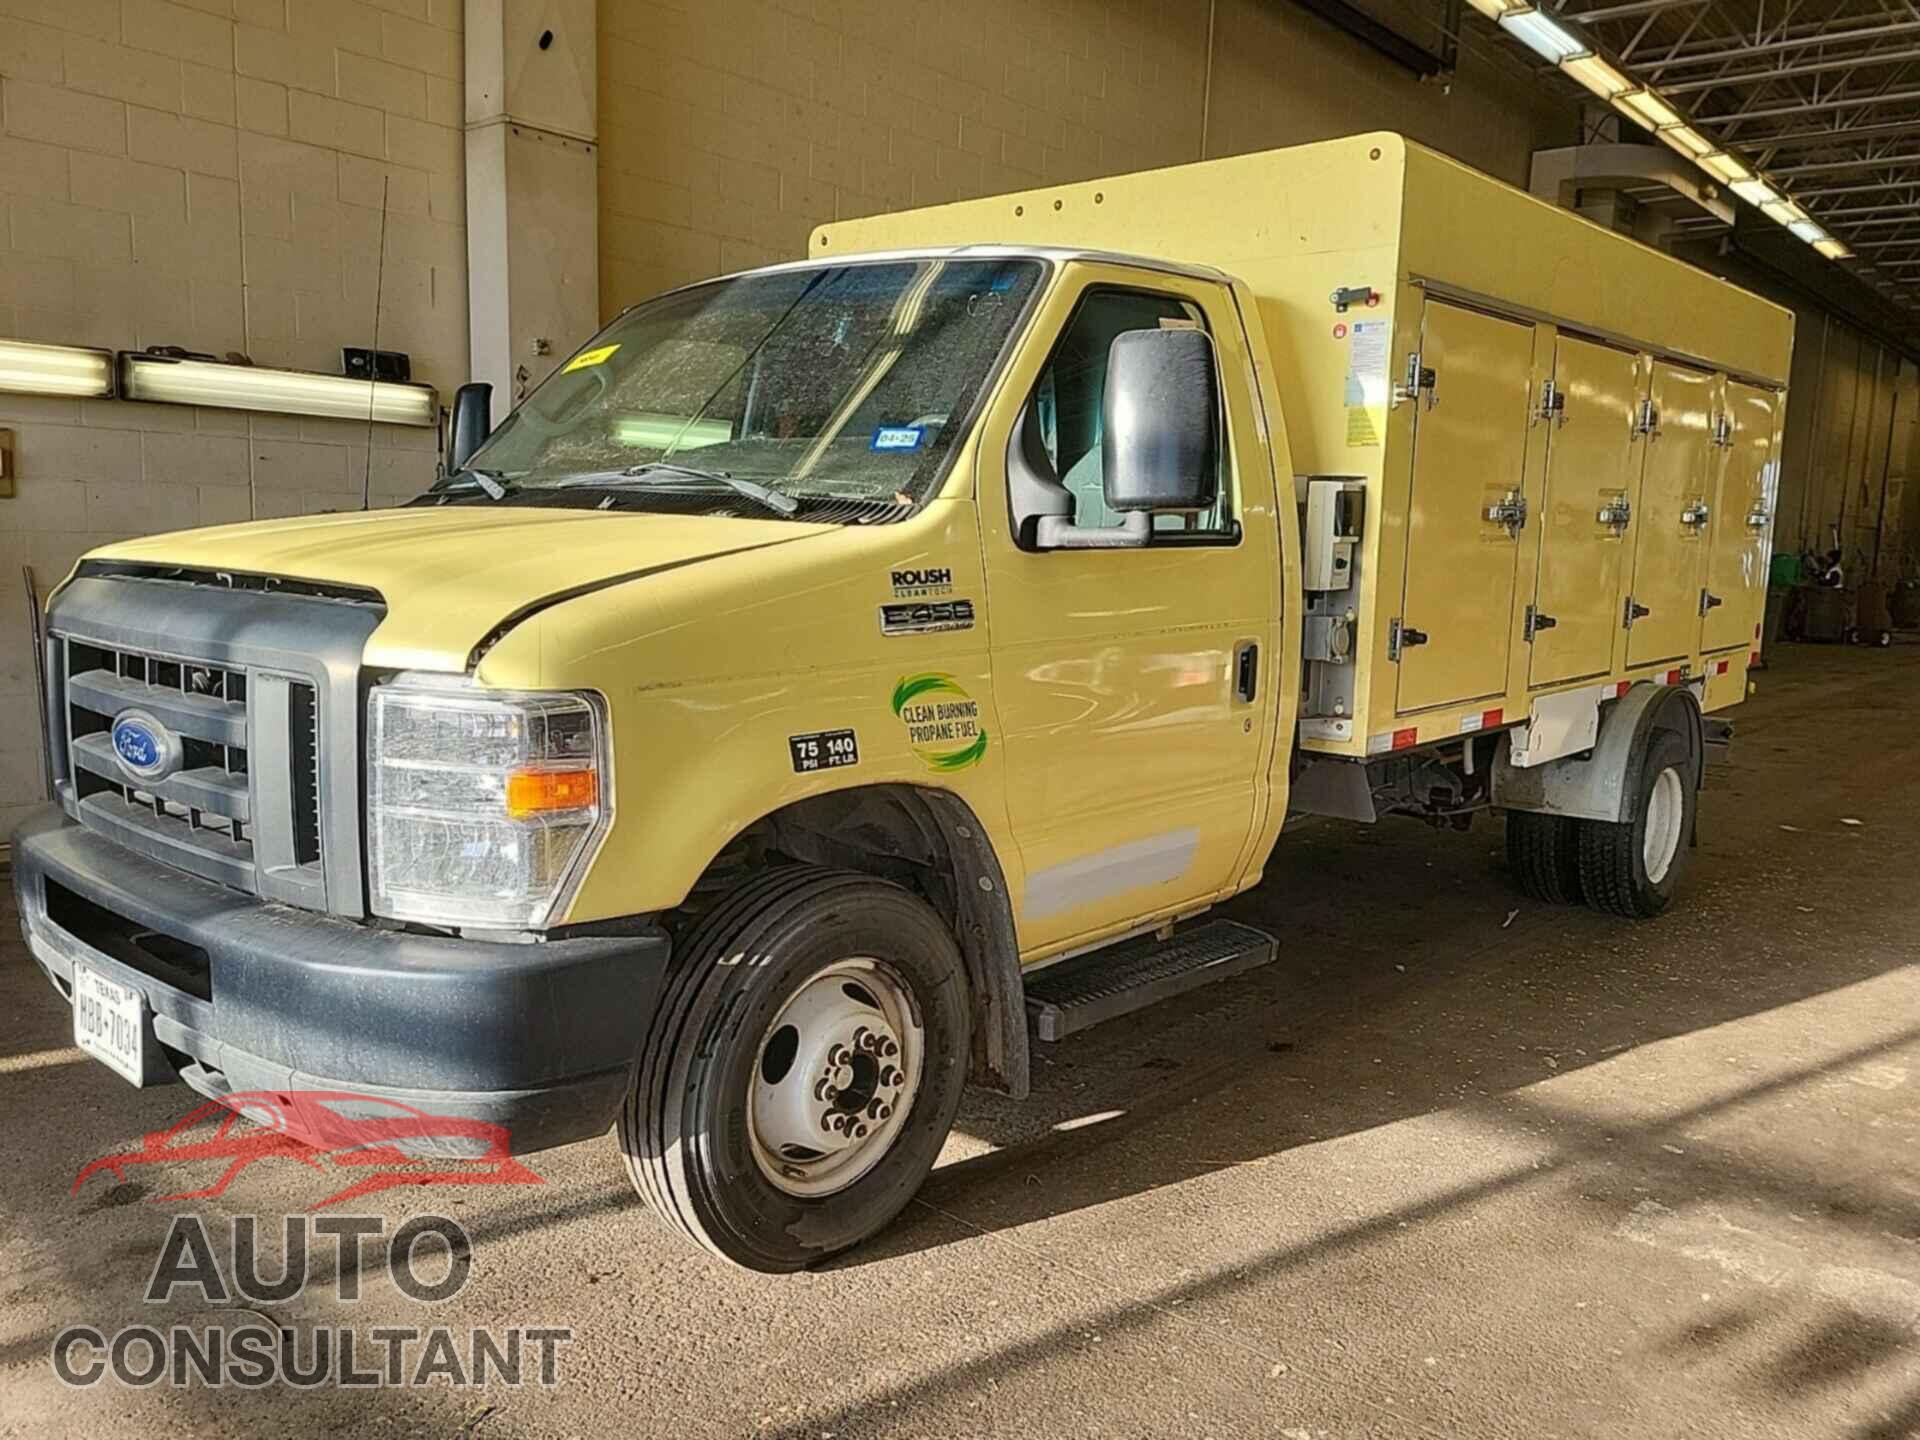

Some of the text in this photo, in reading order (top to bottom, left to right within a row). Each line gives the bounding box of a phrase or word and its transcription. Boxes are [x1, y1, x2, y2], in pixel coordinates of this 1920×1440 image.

[891, 568, 951, 586] ROUSH
[903, 701, 977, 723] CLEAN BURNING
[909, 720, 978, 743] PROPANE FUEL
[119, 728, 148, 763] Ford
[796, 737, 854, 758] 75 140
[802, 758, 818, 769] PSI
[94, 978, 121, 1005] TEXAS
